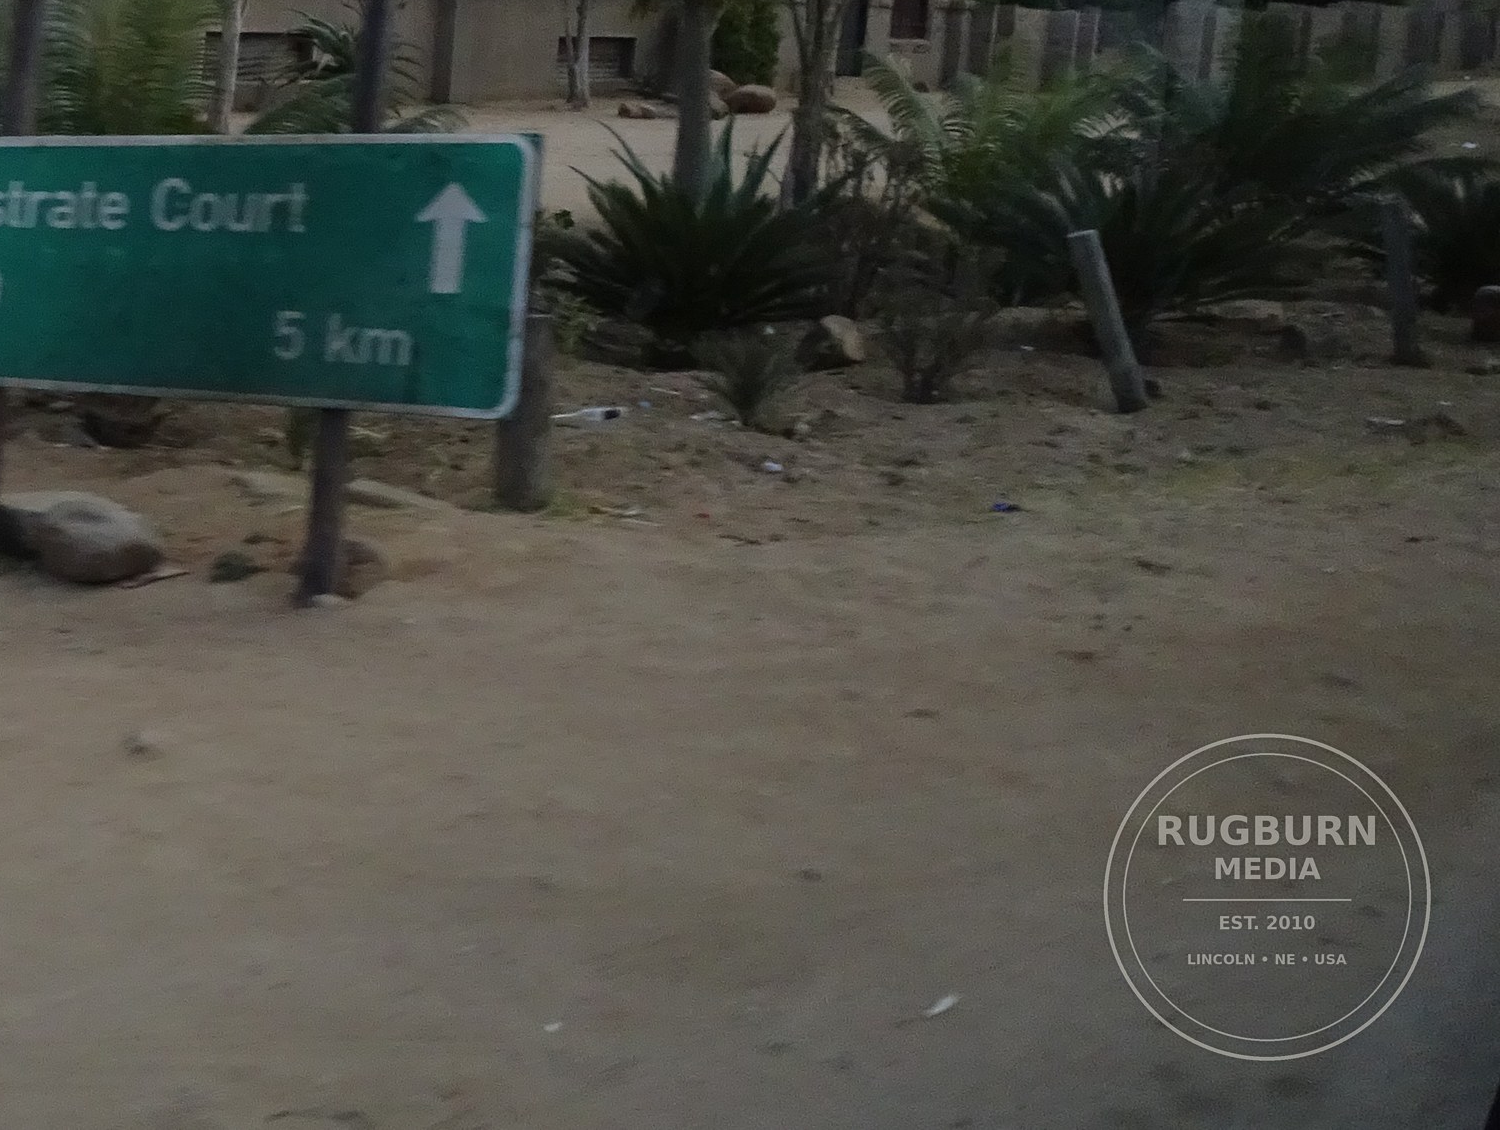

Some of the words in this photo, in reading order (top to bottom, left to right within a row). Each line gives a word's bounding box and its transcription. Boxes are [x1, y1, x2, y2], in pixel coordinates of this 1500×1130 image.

[151, 177, 309, 233] Court
[272, 310, 307, 360] 5
[324, 312, 413, 366] km
